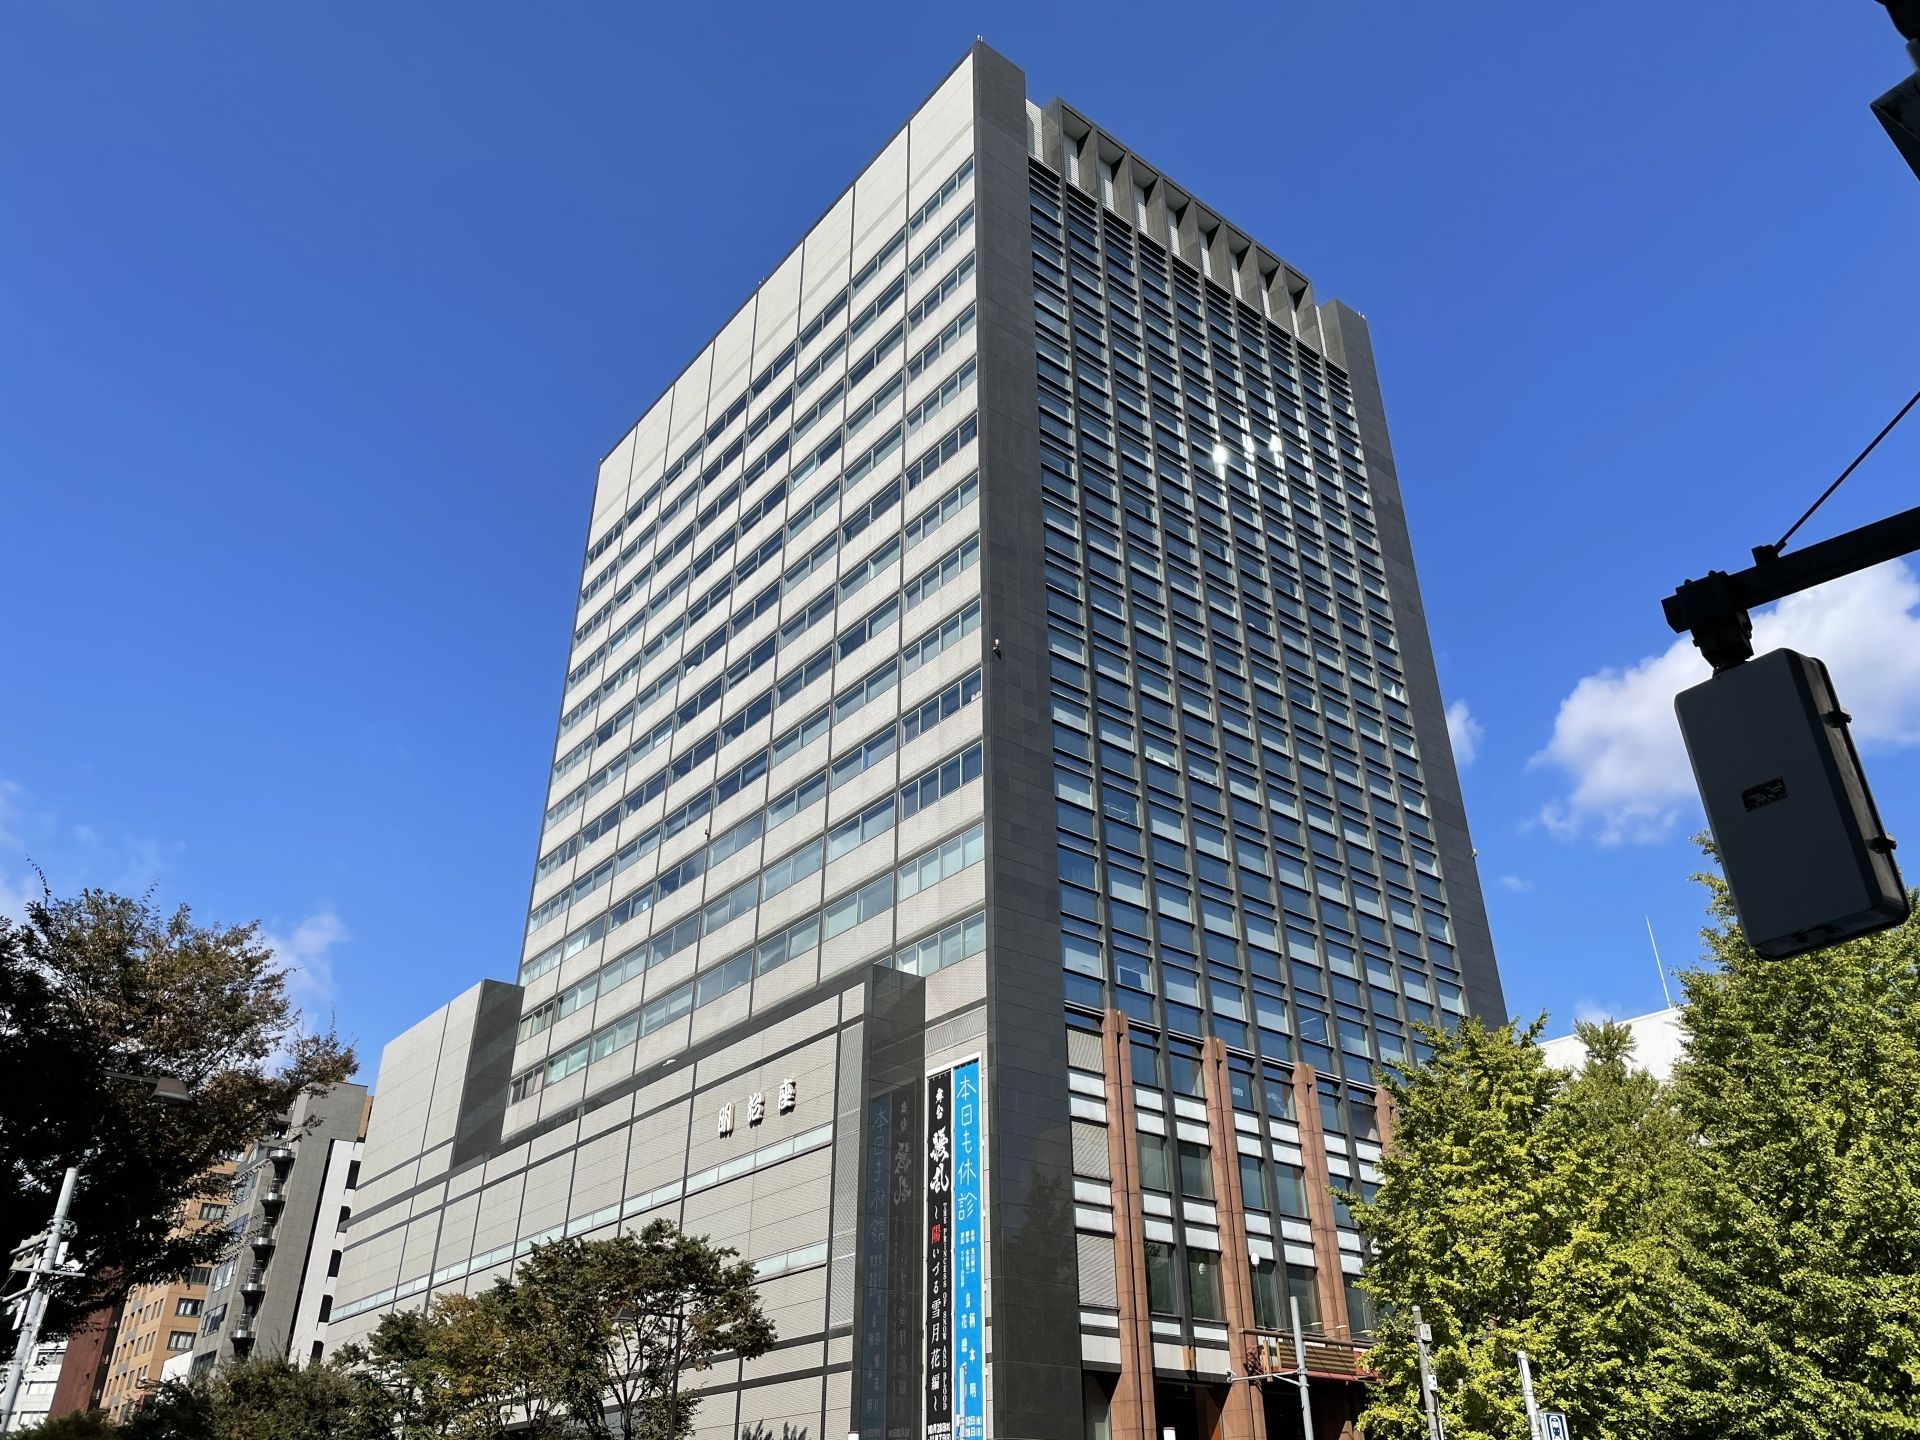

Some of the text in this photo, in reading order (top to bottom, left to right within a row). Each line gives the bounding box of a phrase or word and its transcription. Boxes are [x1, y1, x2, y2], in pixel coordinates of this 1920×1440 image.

[718, 1079, 796, 1134] 明治座
[956, 1074, 978, 1221] 本日も休診
[943, 1291, 947, 1307] OF
